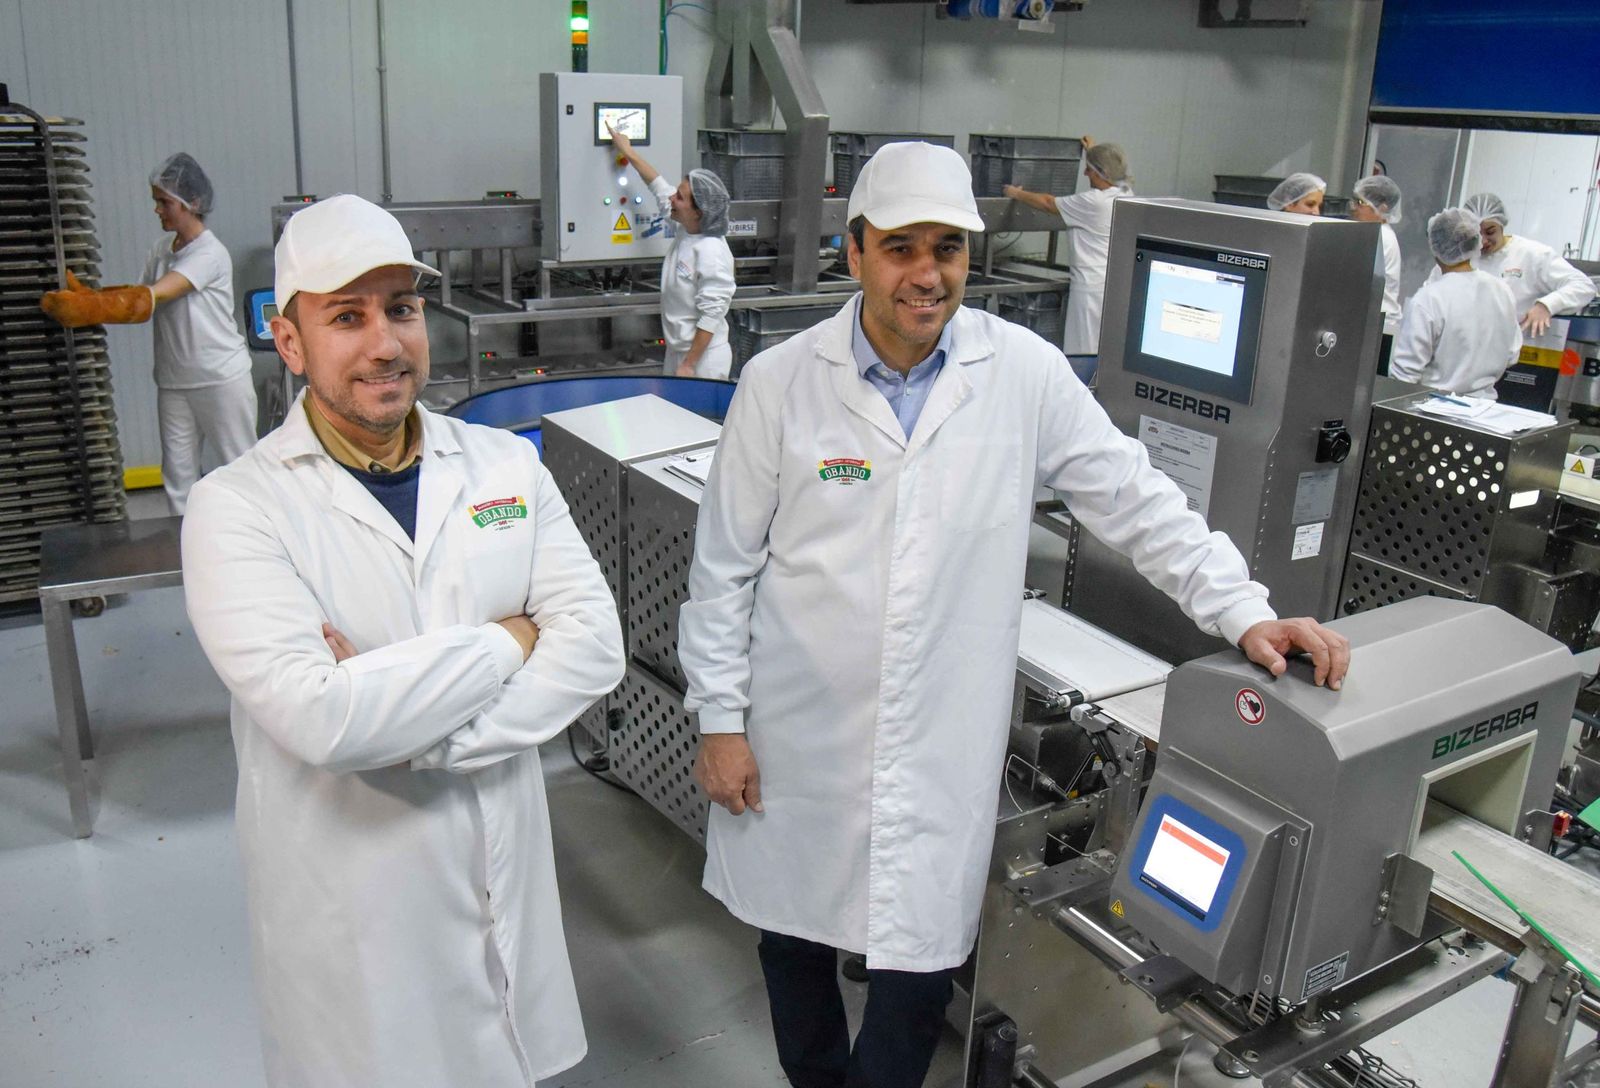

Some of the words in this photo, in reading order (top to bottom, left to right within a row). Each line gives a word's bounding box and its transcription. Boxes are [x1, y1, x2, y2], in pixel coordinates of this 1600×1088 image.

[728, 223, 755, 232] UBIRSE
[1217, 253, 1266, 270] BIZERBA
[1134, 380, 1231, 424] BIZERBA
[824, 466, 866, 479] OBANDO
[477, 506, 522, 525] OBANDO
[1431, 701, 1539, 760] BIZERBA
